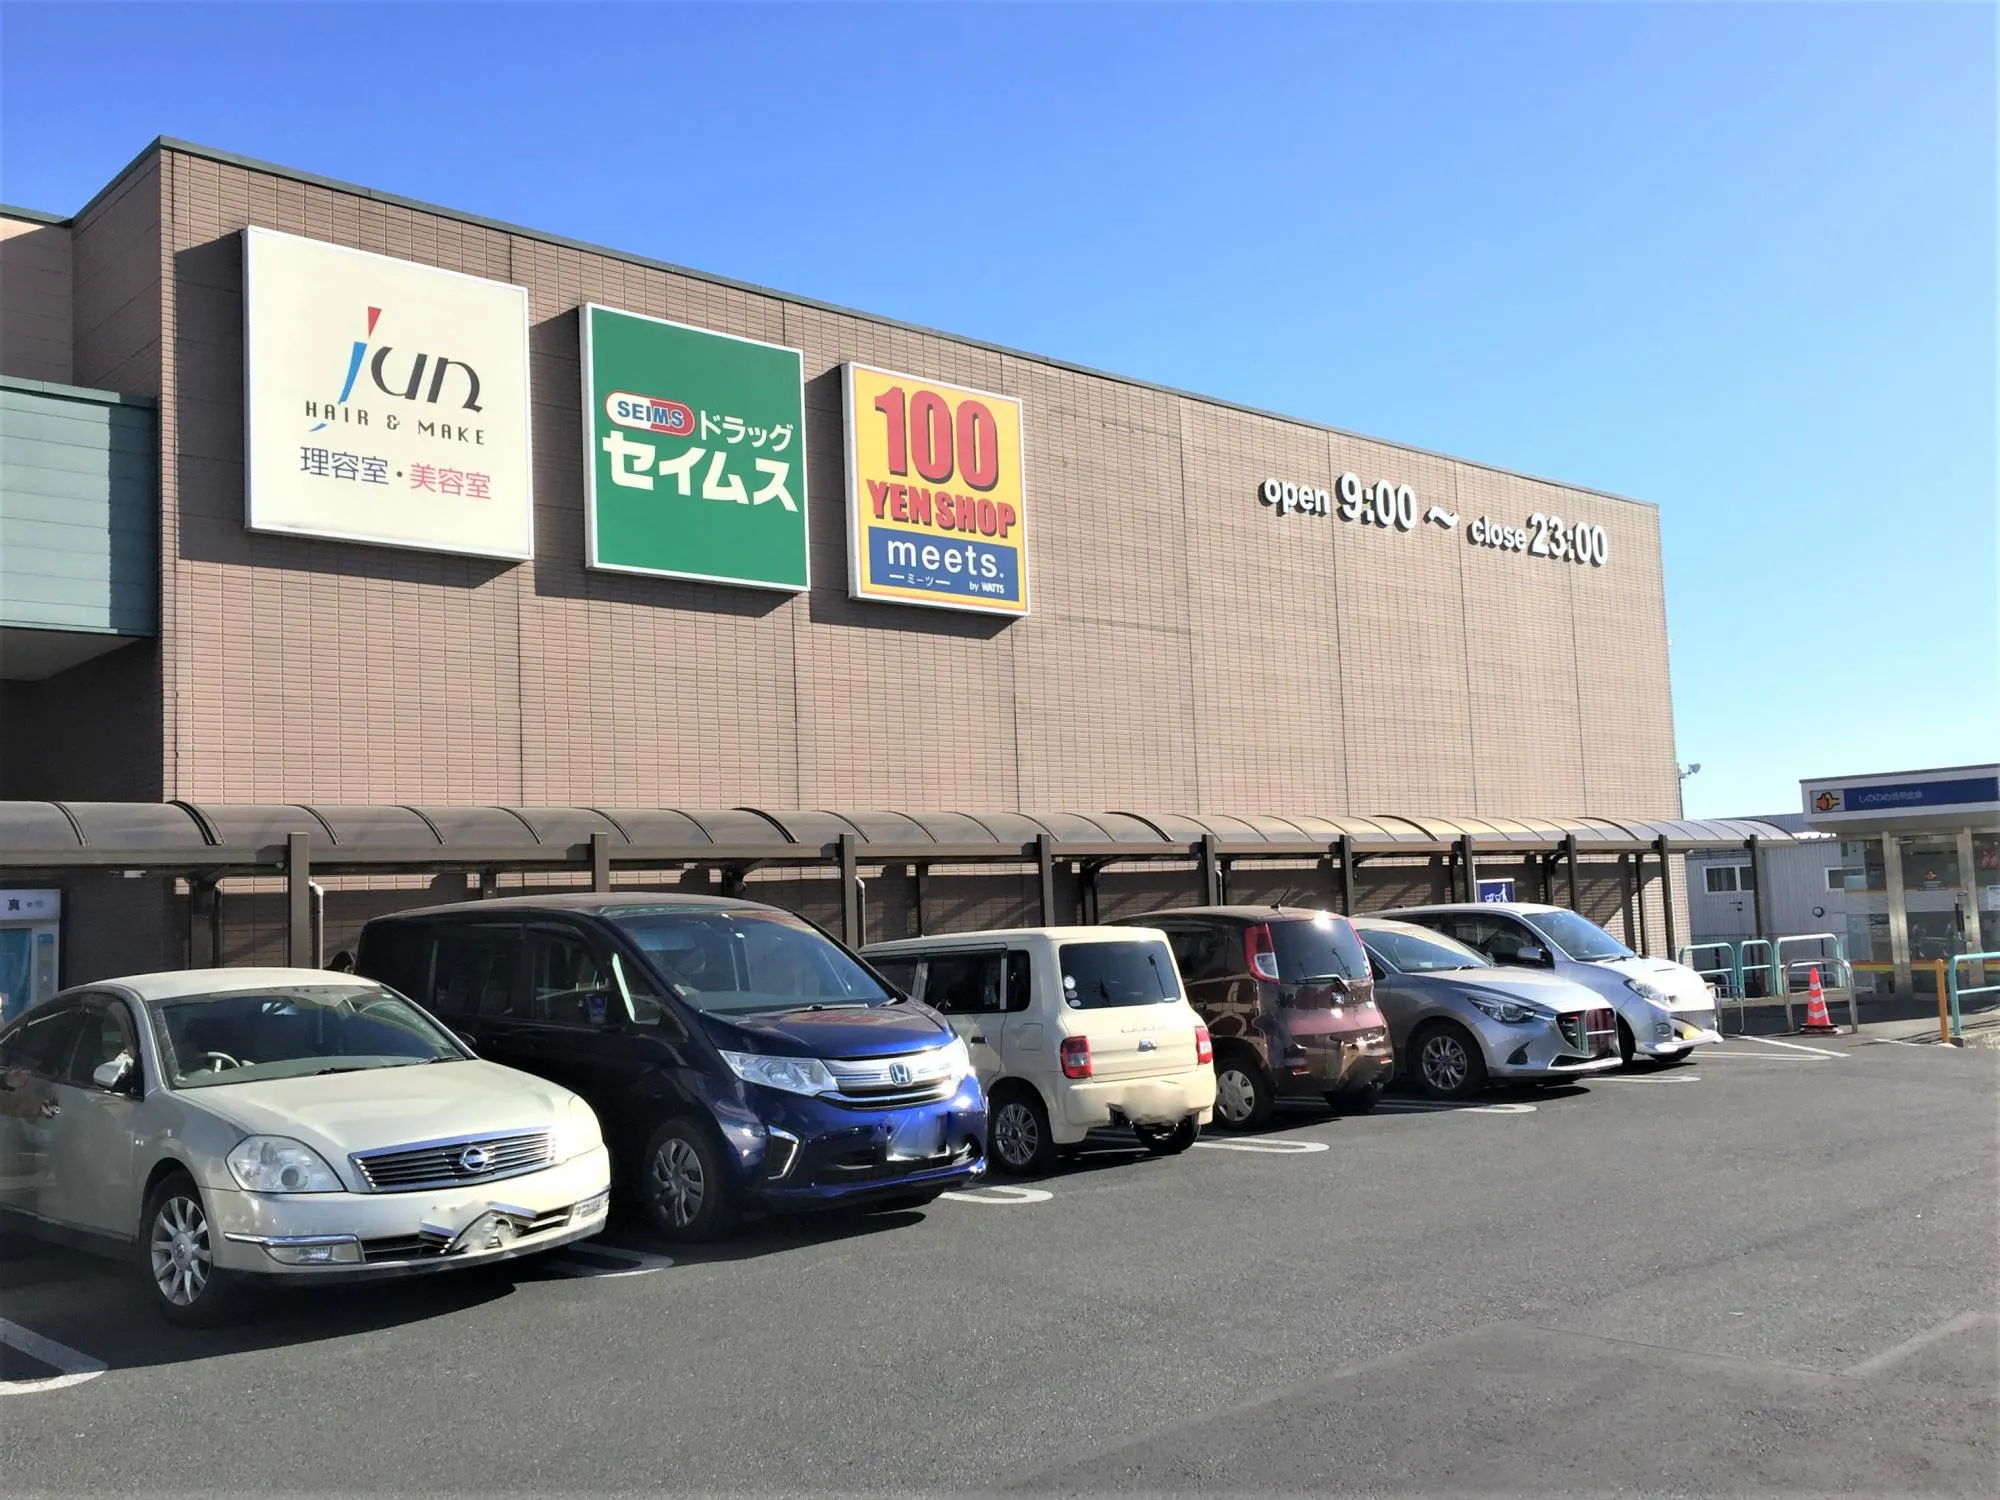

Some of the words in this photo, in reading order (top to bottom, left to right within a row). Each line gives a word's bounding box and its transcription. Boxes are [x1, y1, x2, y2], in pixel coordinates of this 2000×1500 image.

[337, 306, 483, 413] jun
[305, 400, 369, 426] HAIR
[386, 414, 400, 431] &
[418, 420, 485, 446] MAKE
[617, 400, 685, 428] SEIMS
[700, 410, 794, 452] ドラッグ
[875, 386, 999, 492] 100
[602, 430, 799, 512] セイムス
[865, 479, 933, 526] YEN
[934, 491, 1016, 539] SHOP
[1261, 477, 1331, 516] open
[1338, 471, 1418, 531] 9:00
[1469, 515, 1527, 550] close
[1528, 512, 1608, 567] 23:00
[969, 581, 979, 593] by
[981, 582, 1005, 594] WATTS
